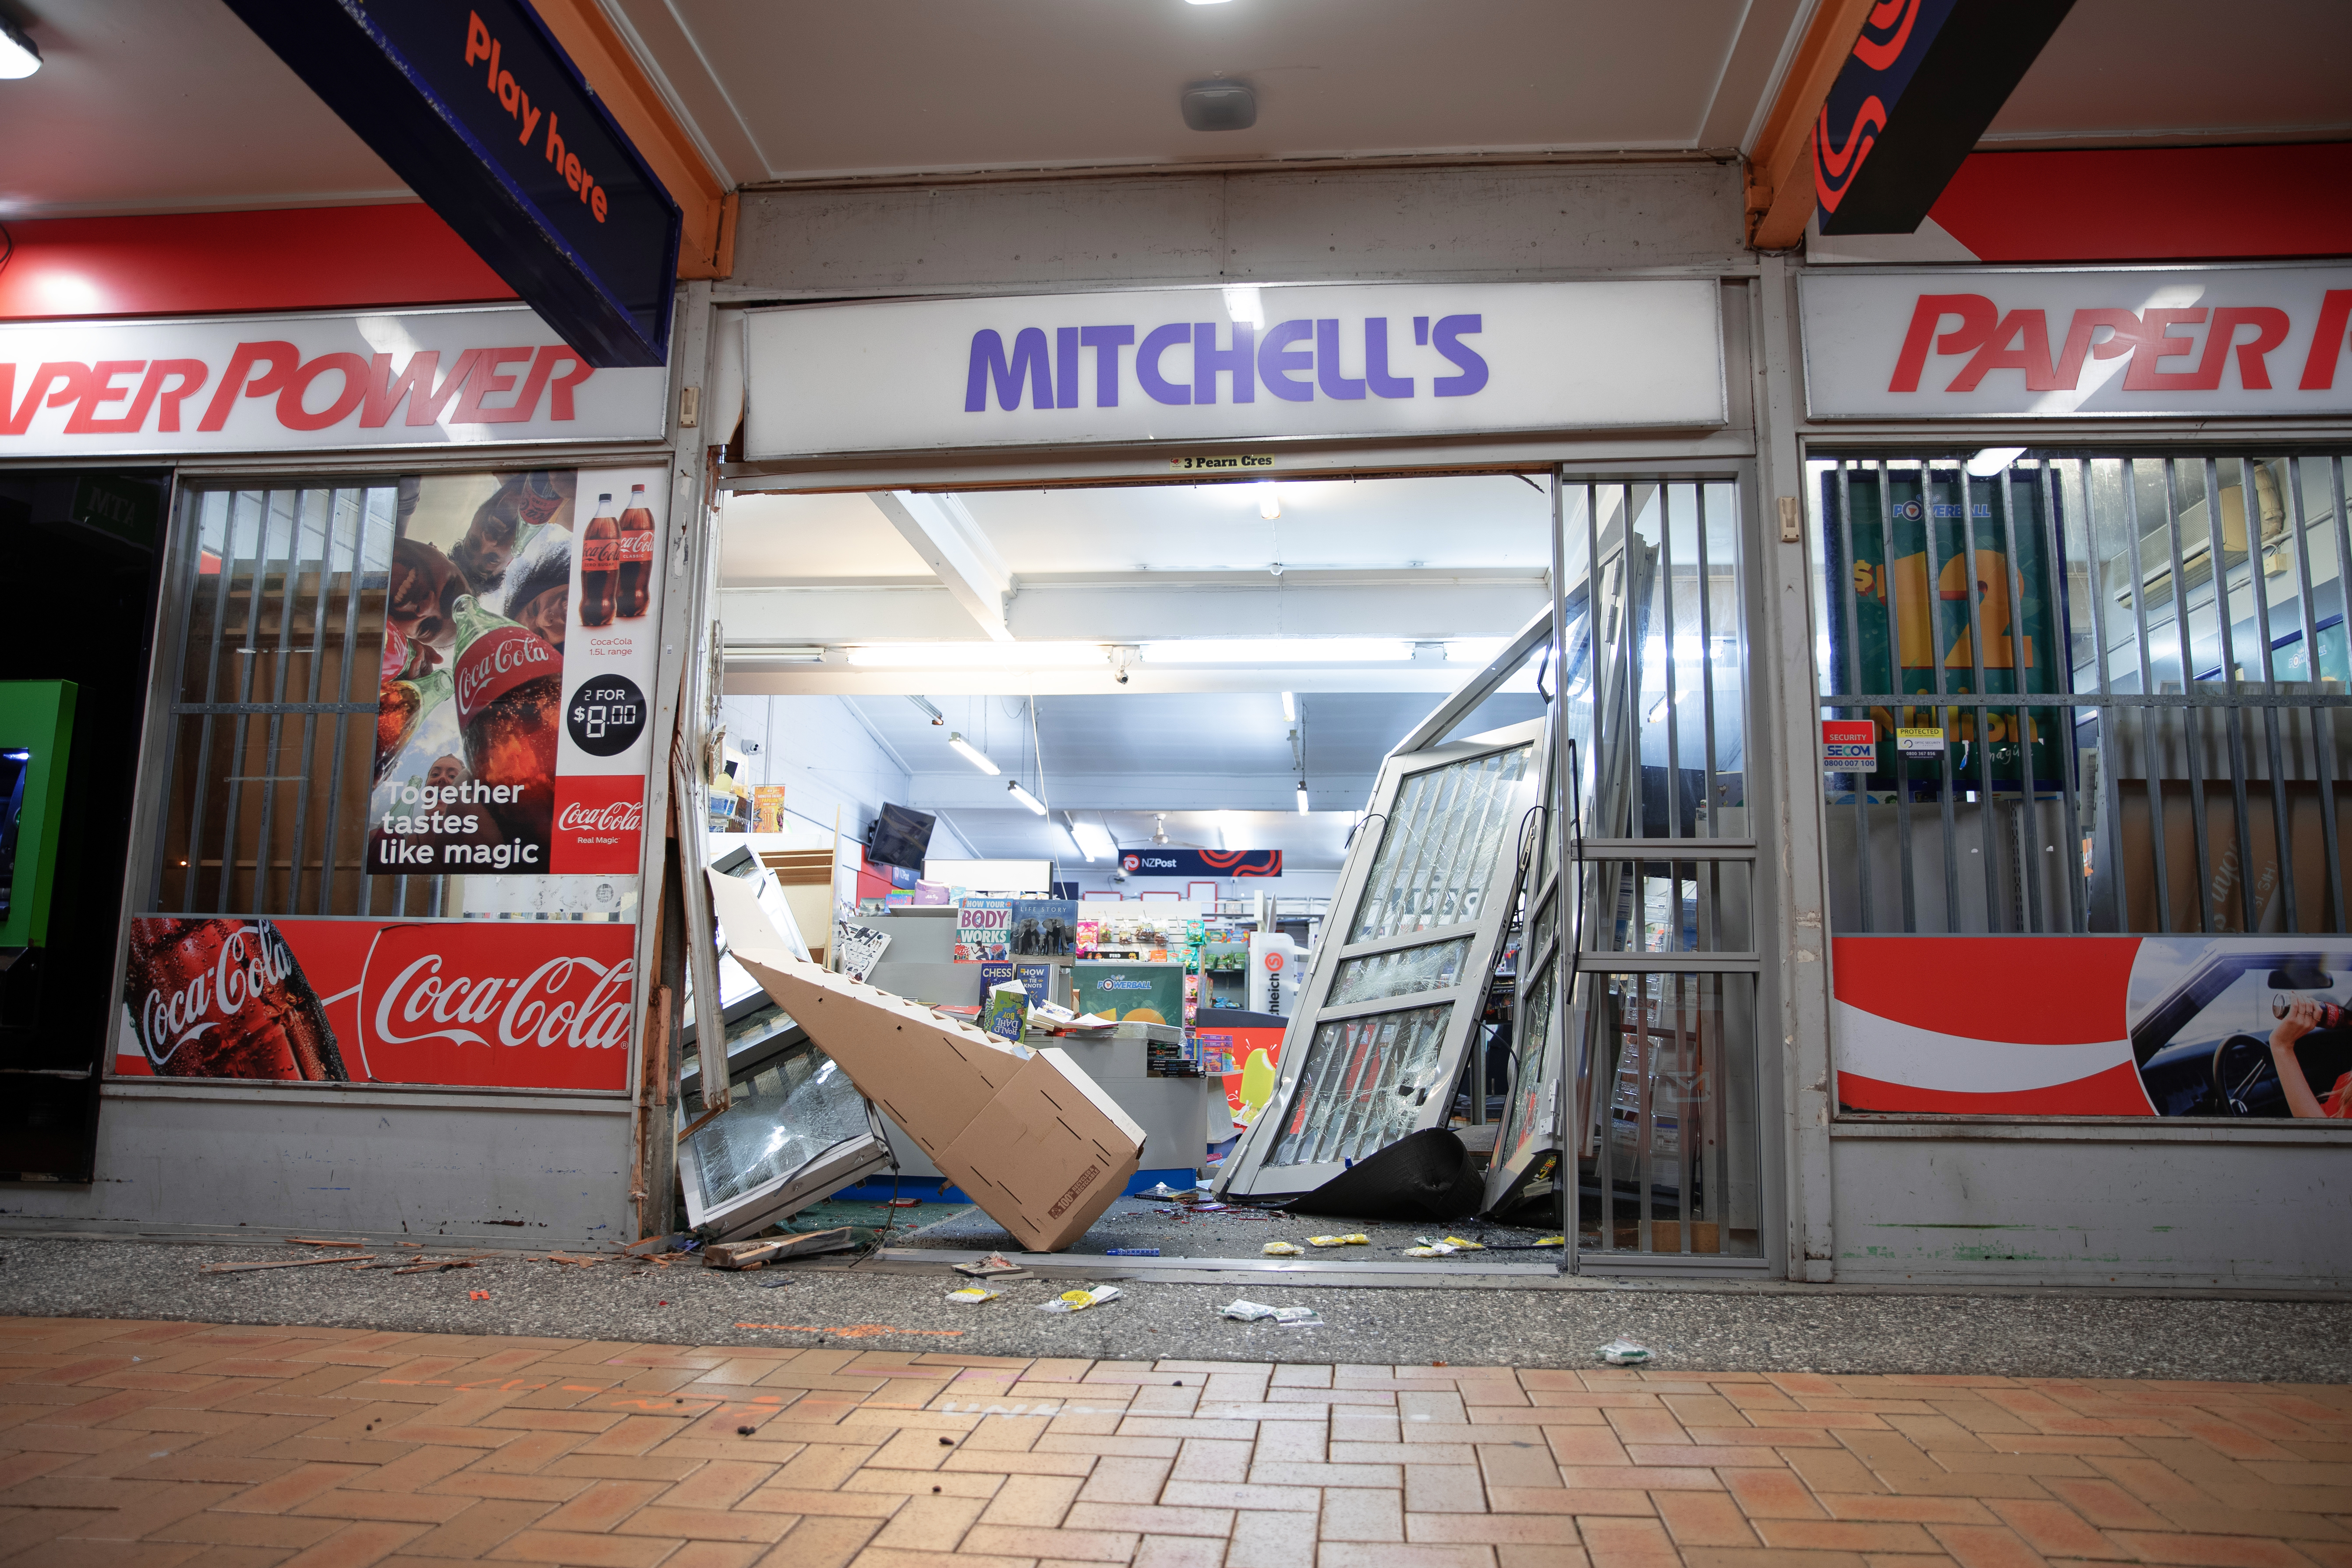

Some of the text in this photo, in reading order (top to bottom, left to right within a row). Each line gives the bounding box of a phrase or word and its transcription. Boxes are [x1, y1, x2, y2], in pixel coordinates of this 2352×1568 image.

[464, 10, 608, 225] Play here
[1888, 294, 2290, 393] PAPER
[964, 314, 1489, 412] MITCHELL'S
[0, 340, 597, 435] PER POWER
[1184, 455, 1273, 468] 3 Pearn Cres
[458, 637, 549, 715] Coca-Cola
[584, 689, 626, 701] 2 FOR
[573, 705, 637, 738] $8.00
[1827, 745, 1871, 757] SECOM
[385, 779, 525, 808] Together
[382, 812, 479, 835] tastes
[558, 802, 644, 831] Coca-Cola
[379, 837, 539, 869] like magic
[1141, 858, 1177, 867] NZPost
[961, 910, 1008, 928] BODY
[960, 930, 1007, 943] WORKS
[983, 968, 1012, 977] CHESS
[1097, 978, 1152, 991] POWERBALL
[143, 919, 292, 1065] Coca-Cola
[375, 954, 634, 1049] Coca-Cola
[996, 1017, 1019, 1029] DAHL
[1002, 1012, 1015, 1020] BOY
[994, 1026, 1018, 1036] ROALD
[1058, 1190, 1074, 1210] 100%
[1072, 1170, 1091, 1192] RECYCLED
[1075, 1168, 1099, 1195] RECYCLABLE
